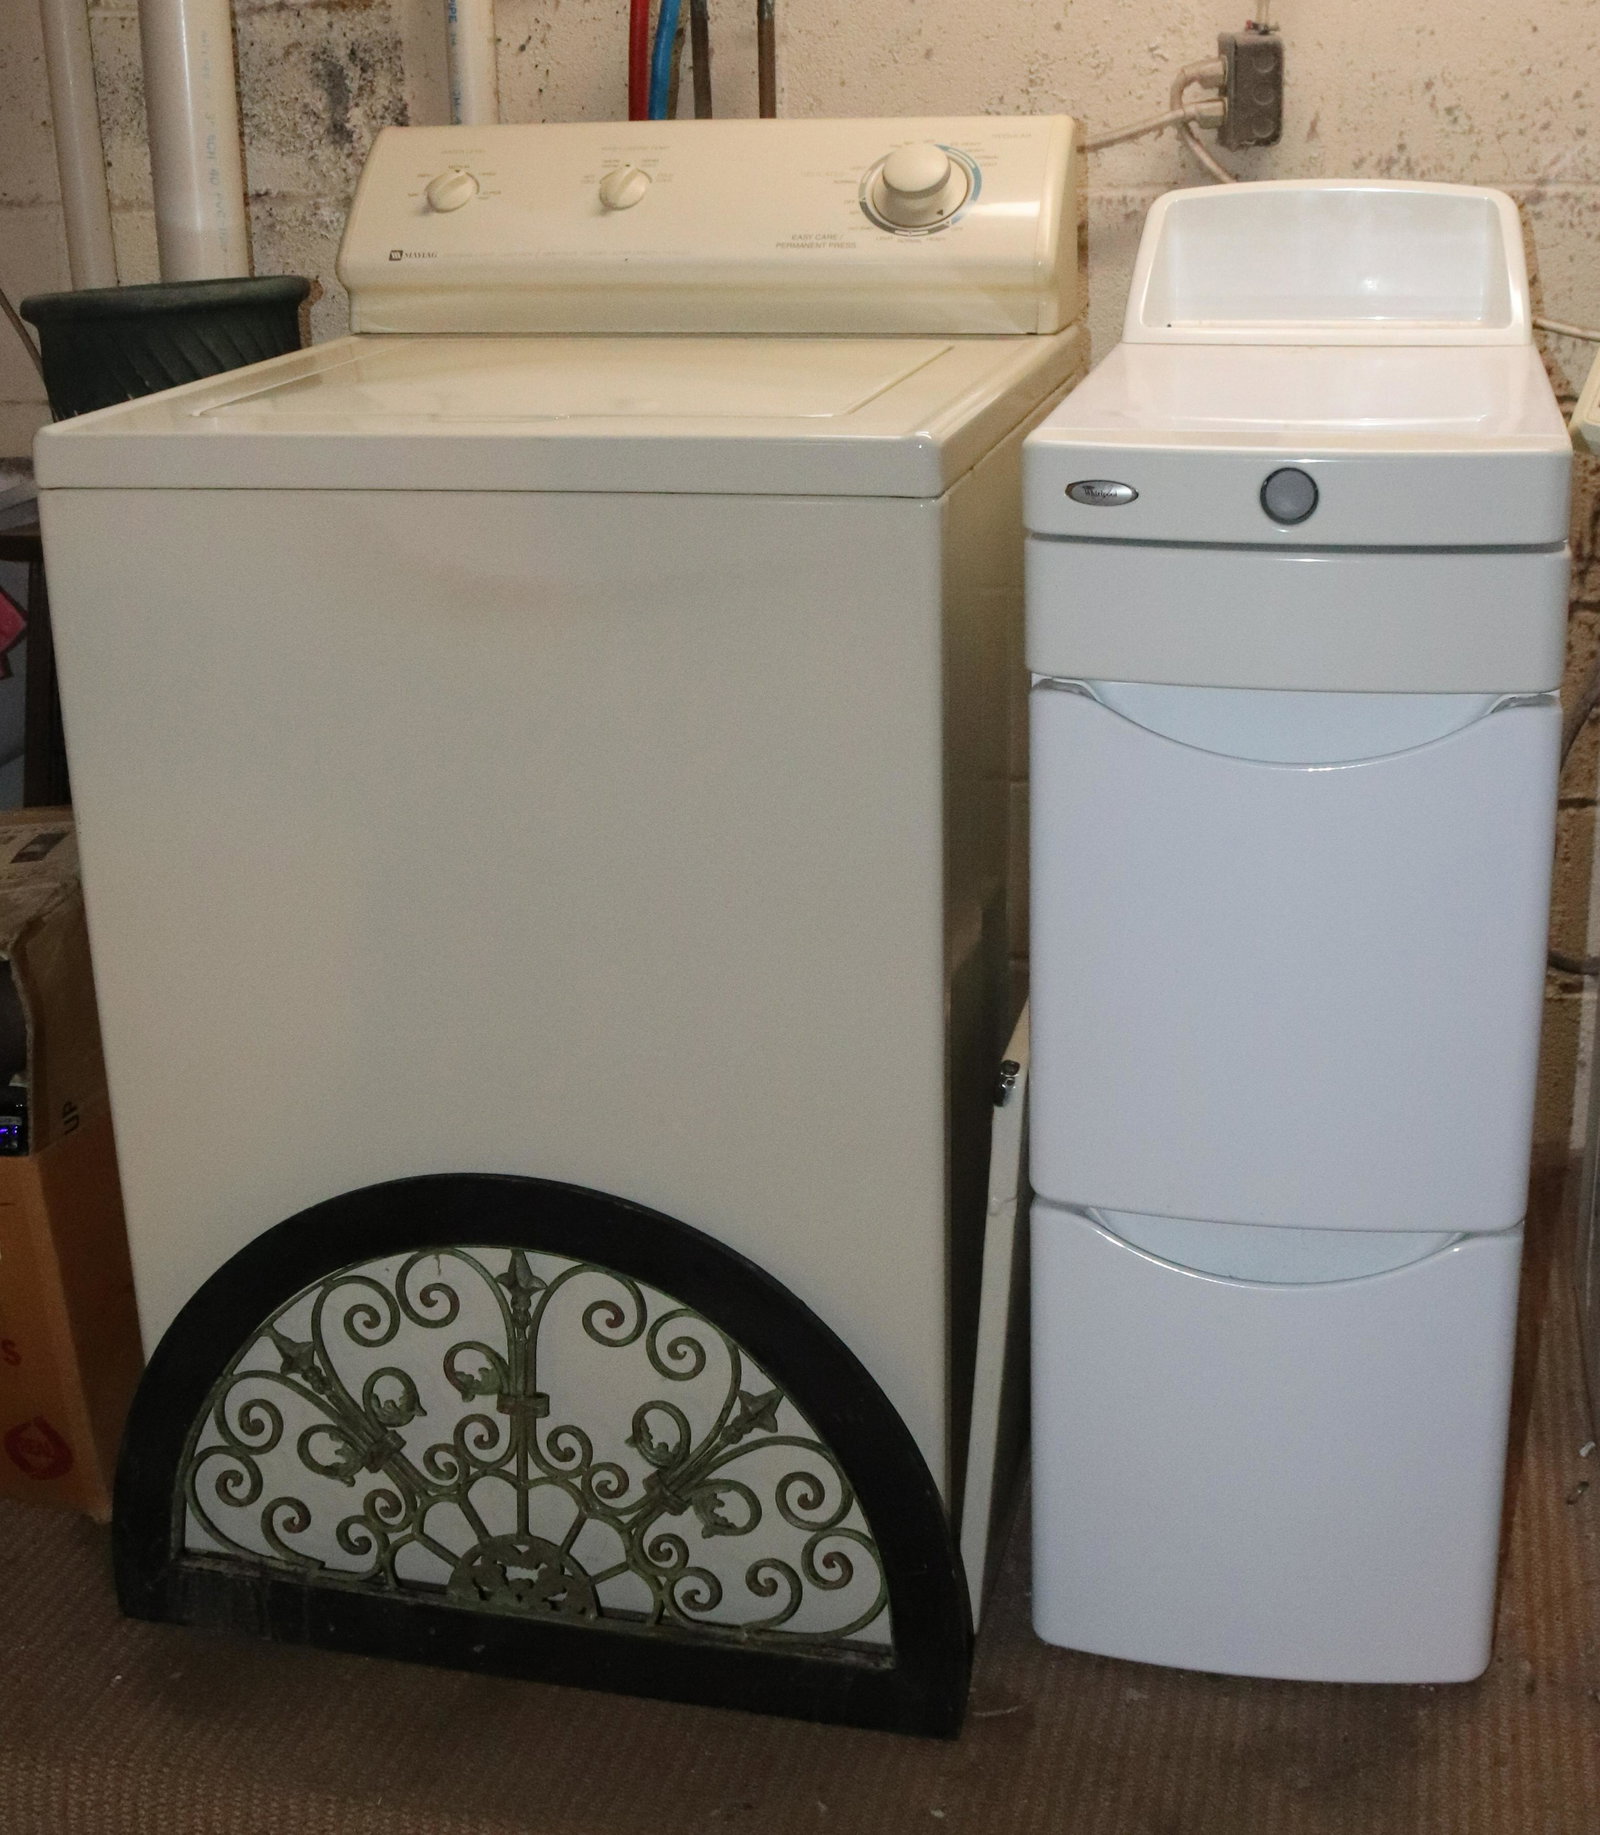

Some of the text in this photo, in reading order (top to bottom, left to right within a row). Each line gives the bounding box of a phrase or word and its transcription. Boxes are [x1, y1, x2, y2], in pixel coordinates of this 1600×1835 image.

[791, 233, 813, 241] EASY
[815, 233, 838, 241] CARE
[776, 241, 857, 249] PERMANENT PRESS
[404, 251, 438, 259] MAYTAG
[1082, 485, 1118, 498] Whirlpool
[62, 1101, 80, 1136] UP
